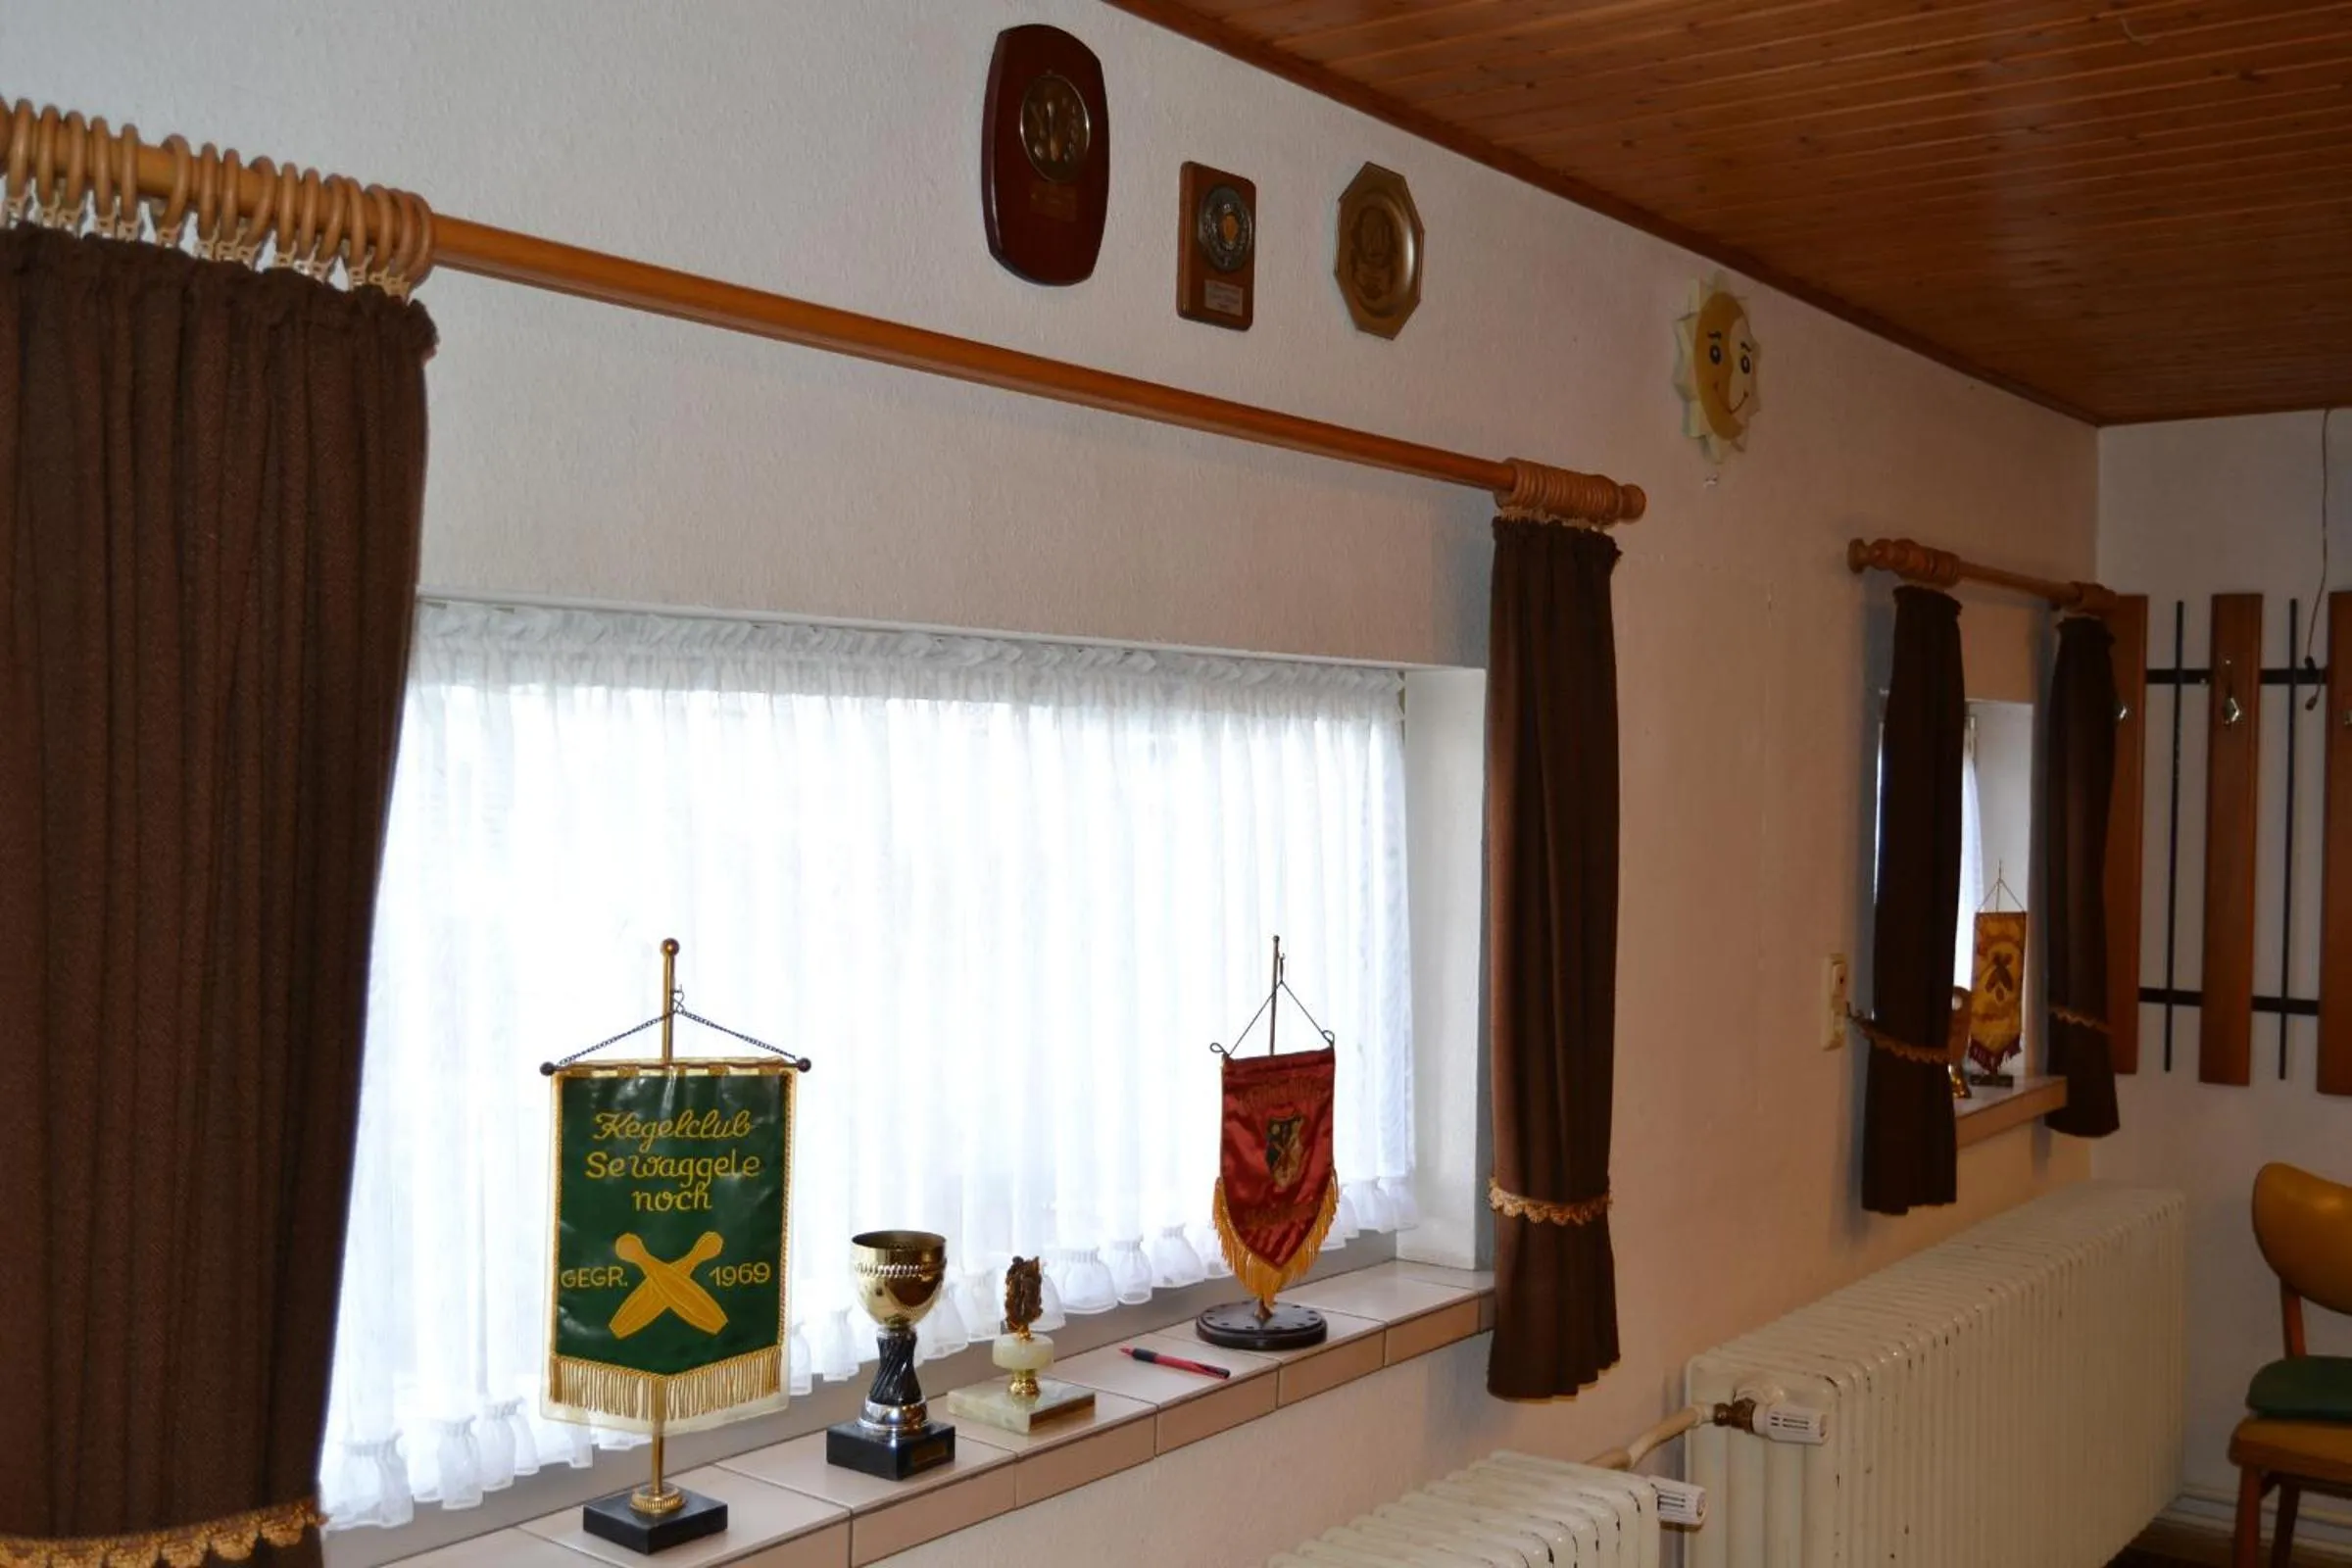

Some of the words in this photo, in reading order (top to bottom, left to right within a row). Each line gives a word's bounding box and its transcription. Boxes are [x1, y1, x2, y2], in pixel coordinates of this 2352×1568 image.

[593, 1108, 752, 1153] Kegelclub
[631, 1181, 713, 1211] noch
[560, 1265, 628, 1289] GEGR.
[709, 1261, 770, 1287] 1969
